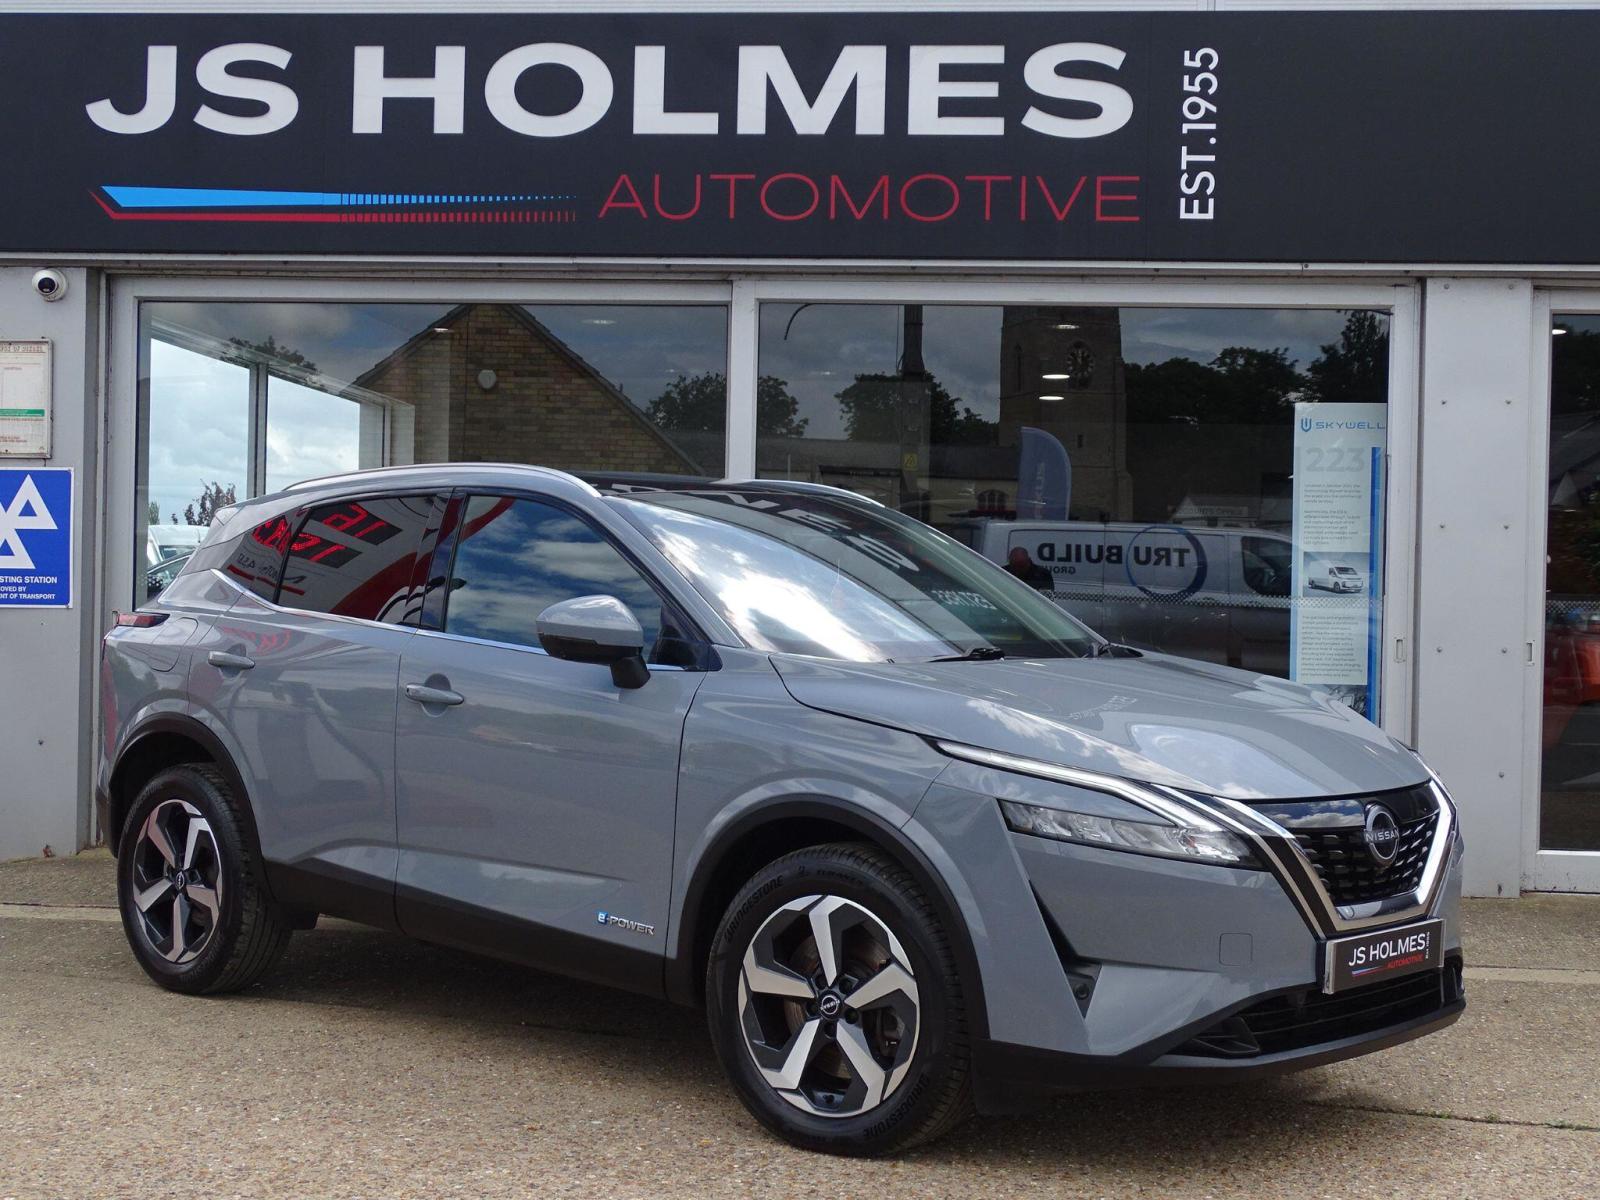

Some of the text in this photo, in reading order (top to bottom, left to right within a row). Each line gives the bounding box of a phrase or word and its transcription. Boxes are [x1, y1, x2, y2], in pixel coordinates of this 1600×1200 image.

[85, 42, 1134, 138] JS HOLMES
[1179, 46, 1219, 220] EST.1955
[598, 173, 1140, 222] AUTOMOTIVE
[1315, 421, 1385, 430] SKYWELL
[24, 576, 58, 584] STATION
[1348, 946, 1366, 966] JS
[1370, 934, 1425, 961] HOLMES
